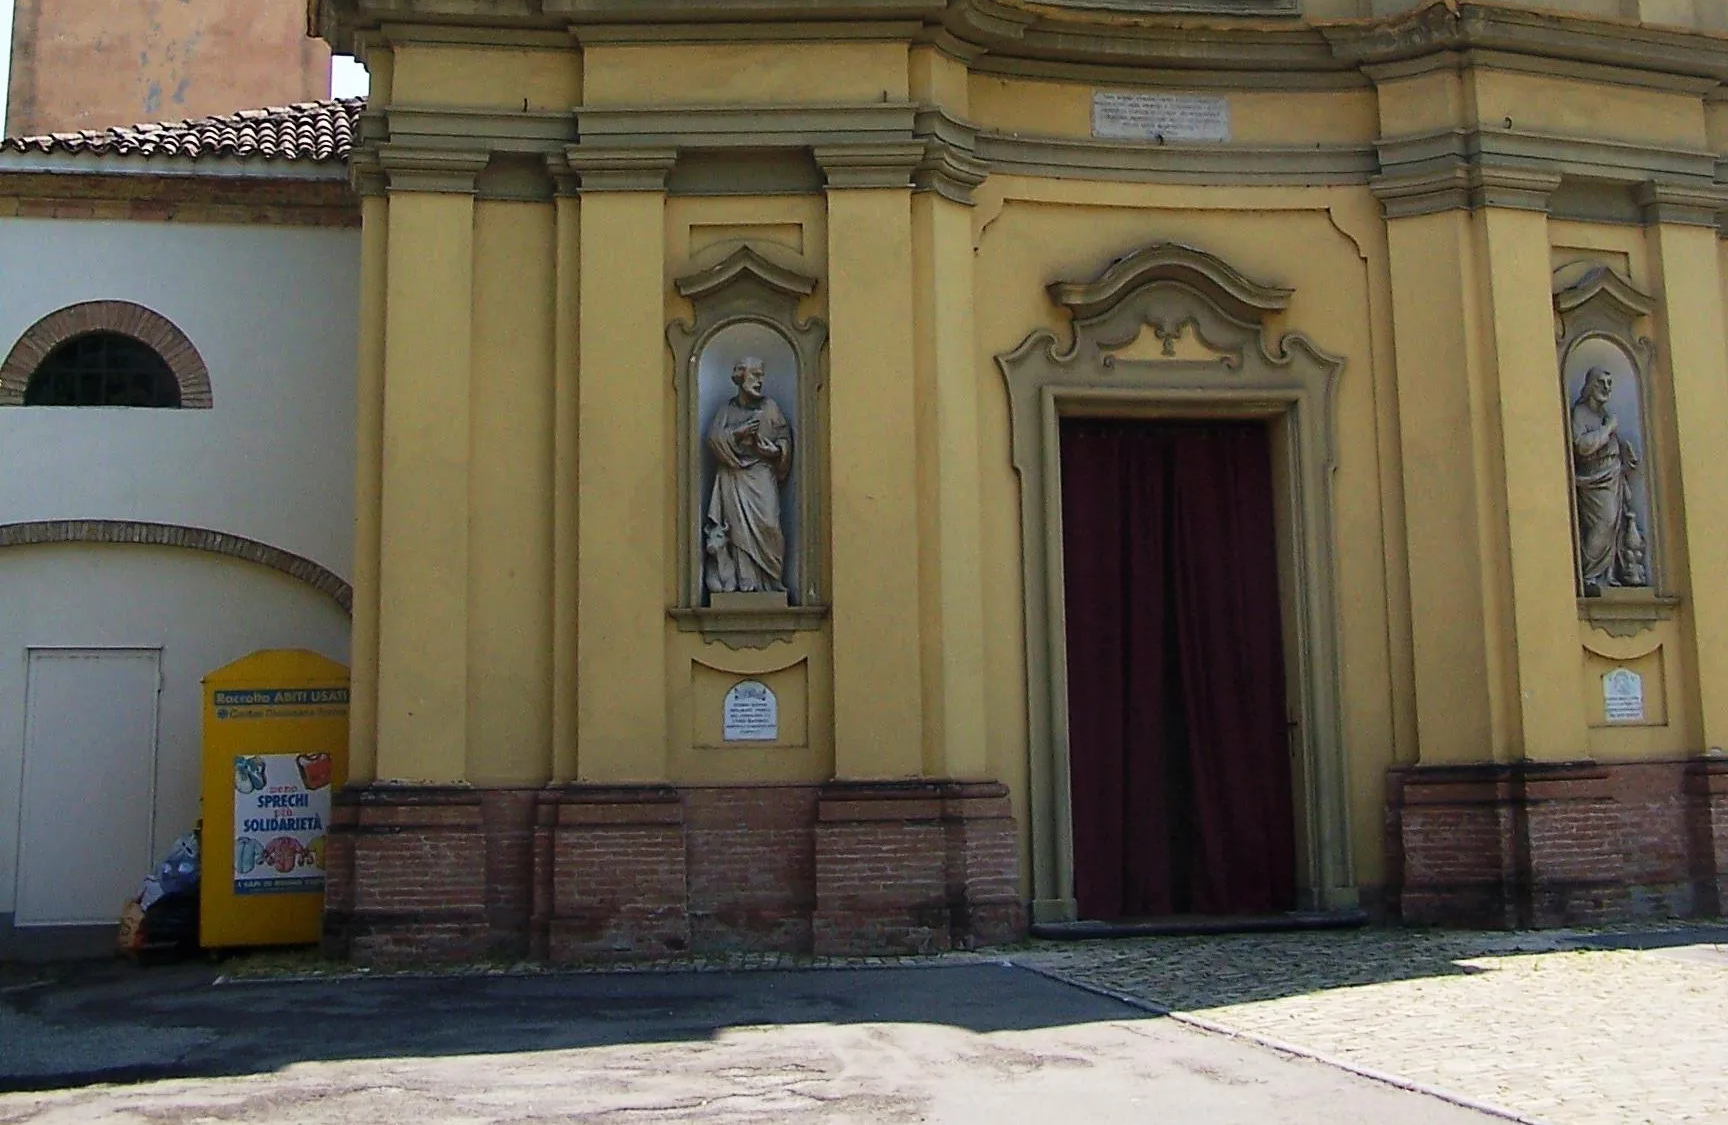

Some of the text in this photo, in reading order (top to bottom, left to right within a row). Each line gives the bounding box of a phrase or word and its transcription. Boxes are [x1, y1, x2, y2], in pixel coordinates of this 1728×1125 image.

[274, 691, 307, 703] ABITI
[311, 689, 348, 702] USATI
[257, 793, 309, 808] SPRECHI
[243, 812, 322, 832] SOLIDARIETÀ
